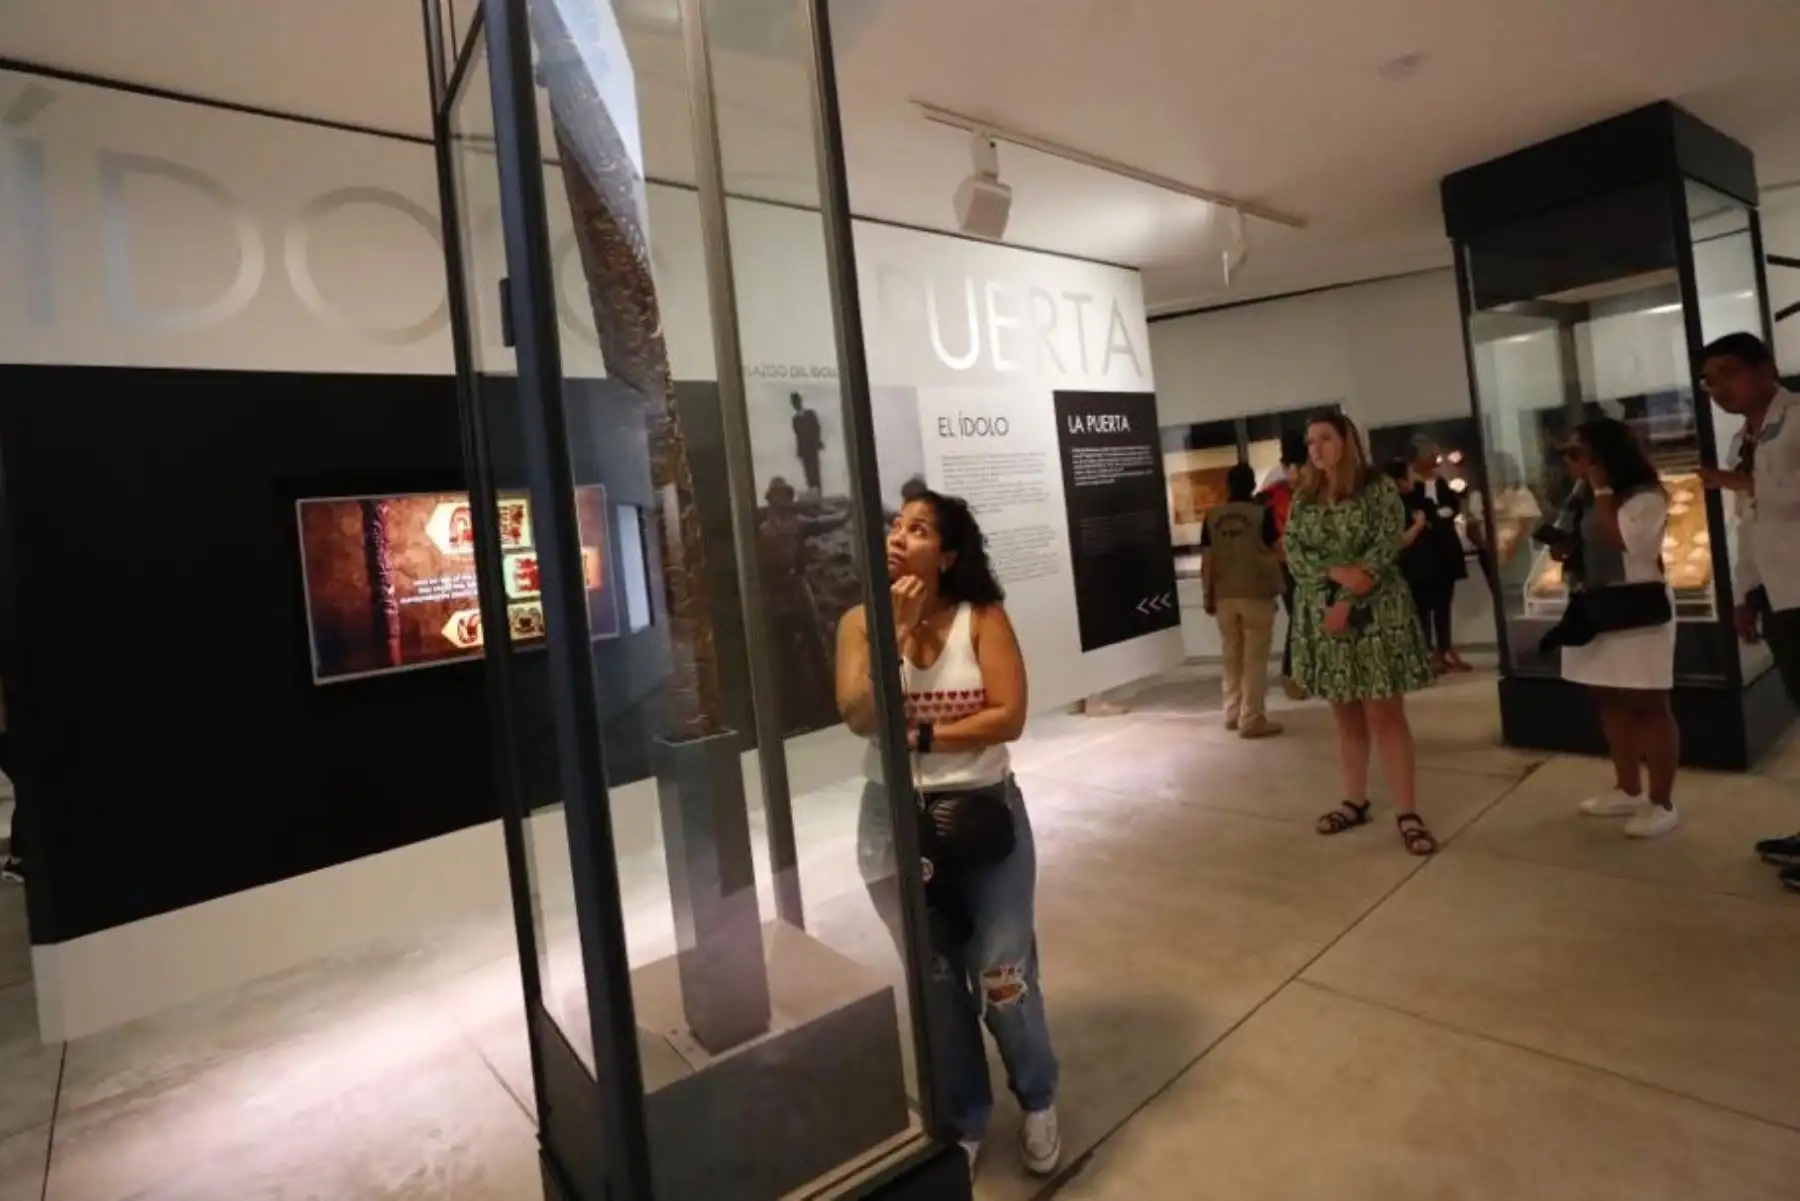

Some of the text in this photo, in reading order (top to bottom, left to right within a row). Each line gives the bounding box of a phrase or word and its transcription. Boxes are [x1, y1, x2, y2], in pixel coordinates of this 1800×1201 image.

[938, 410, 1009, 439] EL ÍDOLO
[1067, 414, 1131, 434] LA PUERTA
